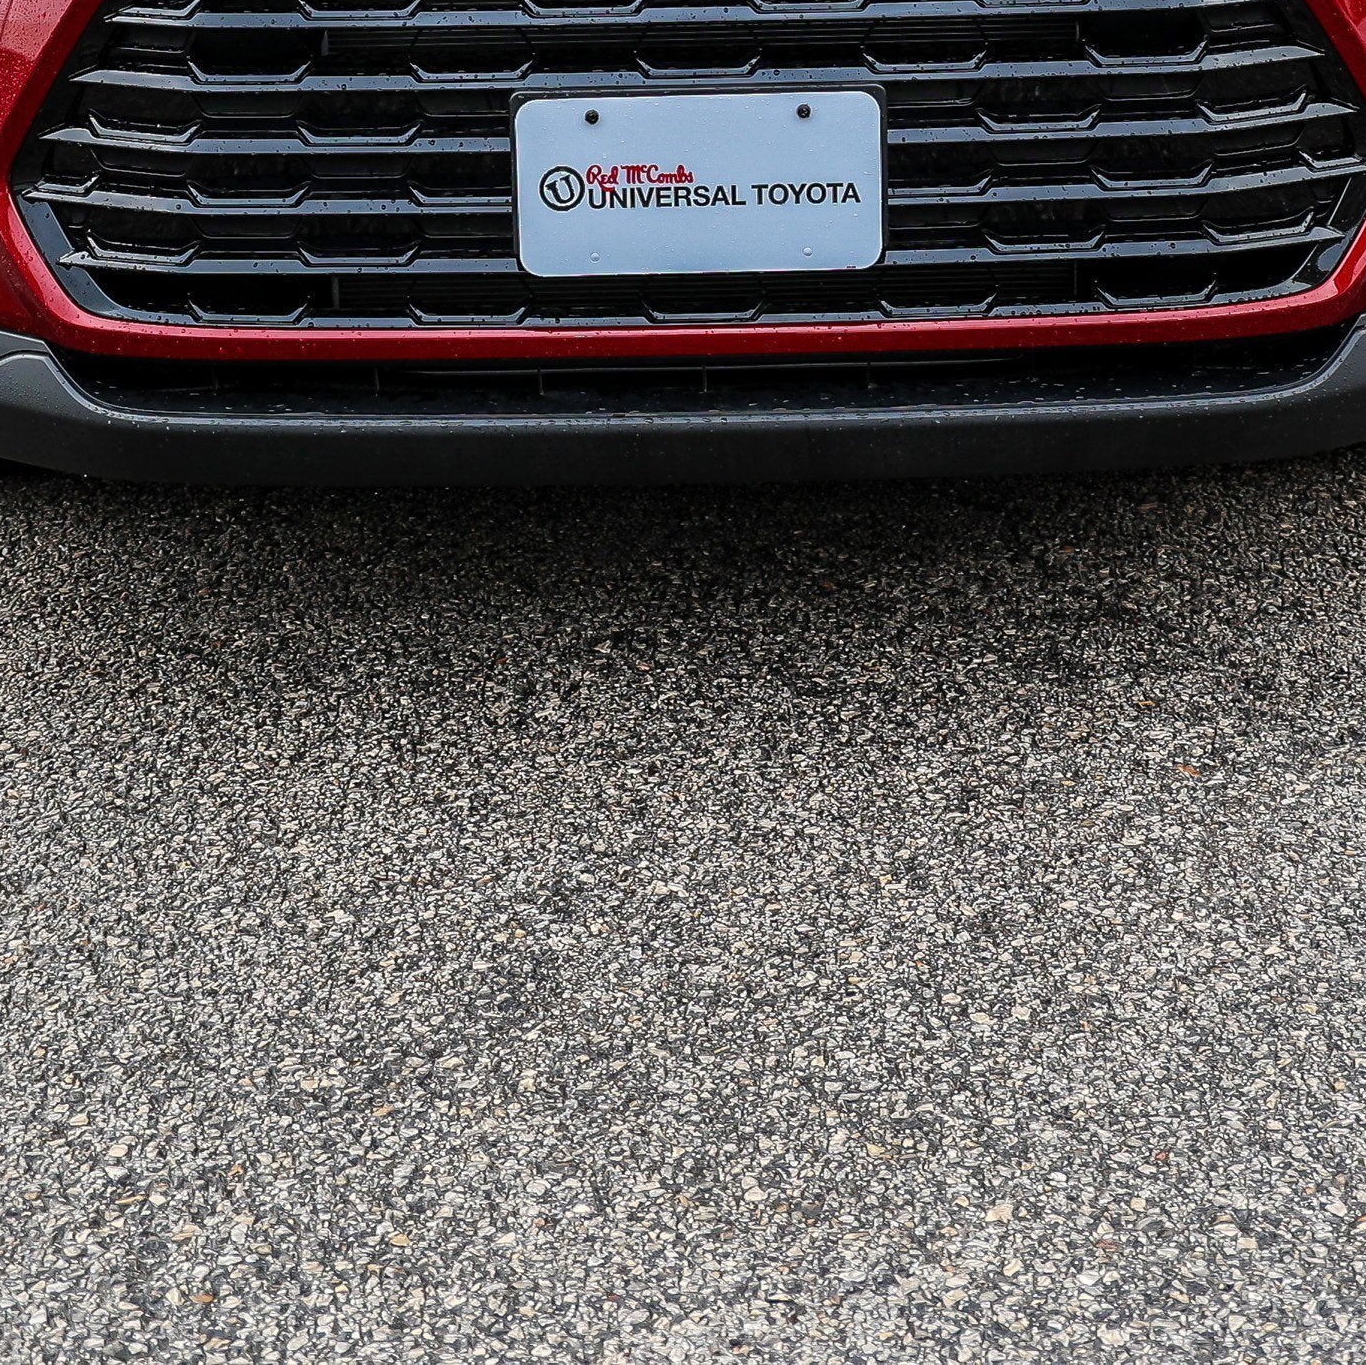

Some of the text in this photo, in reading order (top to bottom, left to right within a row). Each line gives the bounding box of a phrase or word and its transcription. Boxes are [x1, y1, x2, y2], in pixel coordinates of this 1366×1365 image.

[586, 164, 694, 192] Red McCombs
[588, 181, 861, 209] UNIVERSAL TOYOTA
